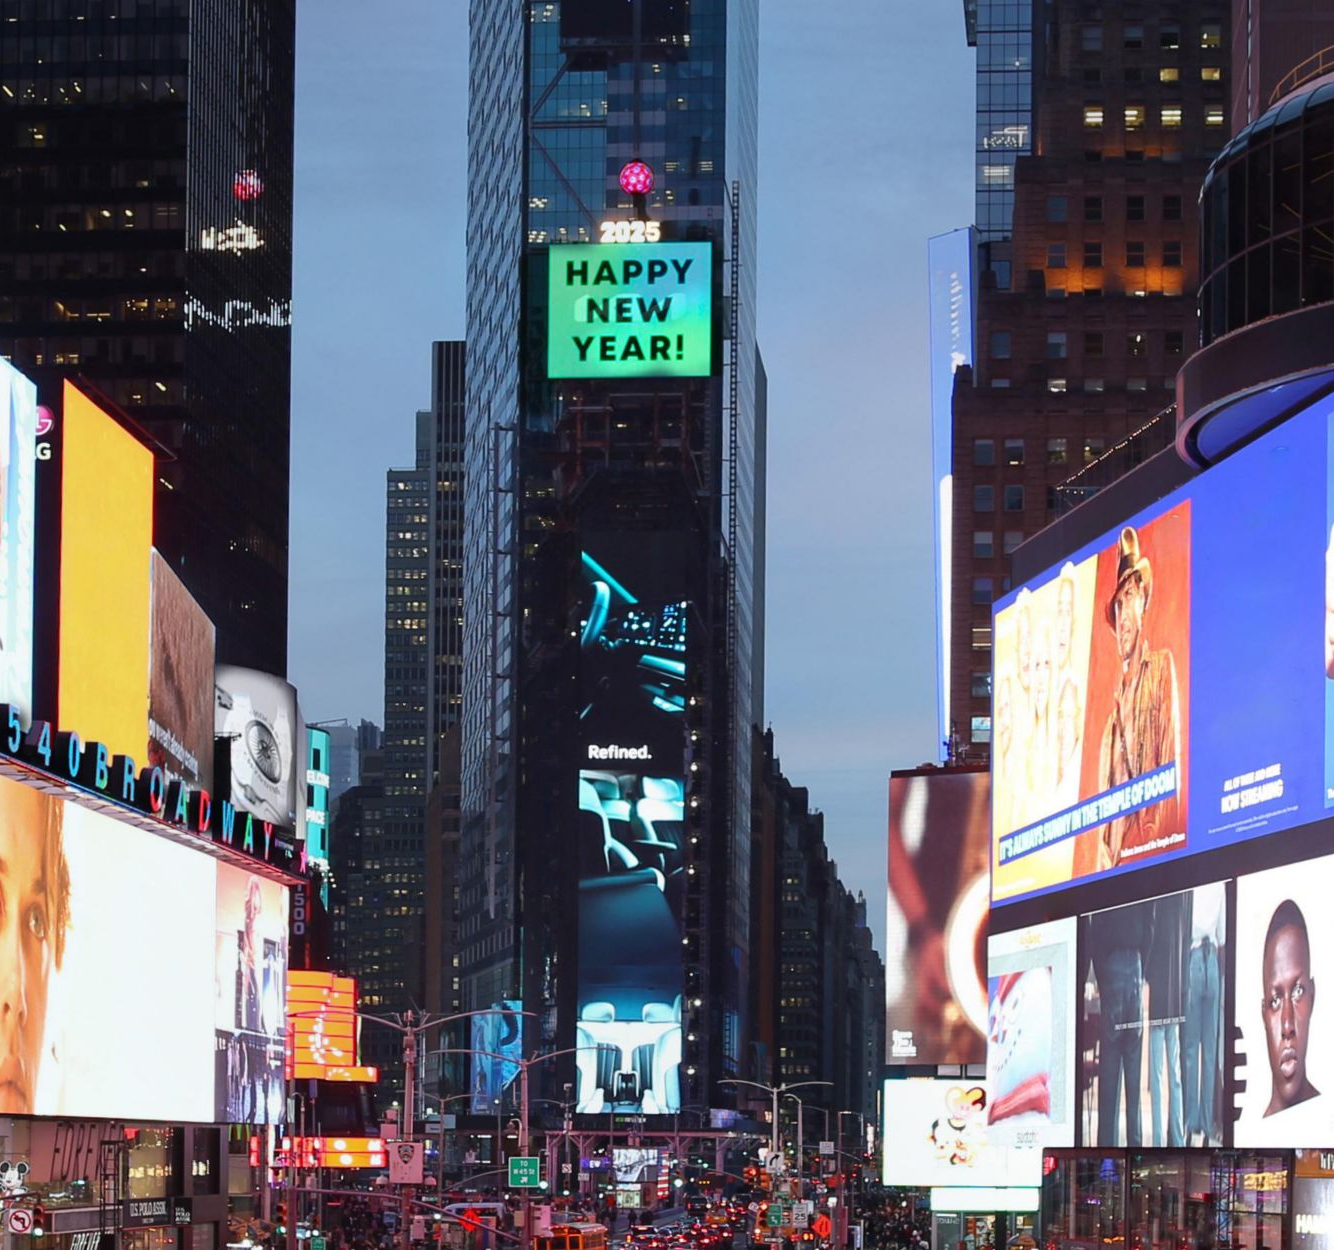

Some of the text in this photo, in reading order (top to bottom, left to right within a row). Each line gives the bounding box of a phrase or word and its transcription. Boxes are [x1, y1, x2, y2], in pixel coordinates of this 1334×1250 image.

[600, 221, 660, 243] 2025
[567, 259, 693, 285] HAPPY
[586, 297, 673, 323] NEW
[572, 334, 685, 361] YEAR!
[35, 443, 51, 459] G
[588, 744, 652, 760] Refined.
[96, 742, 273, 860] BROADWAY
[1012, 823, 1044, 856] ALWAYS
[1044, 811, 1072, 842] SUNNY
[1071, 808, 1082, 831] IN
[1082, 803, 1098, 827] THE
[1098, 788, 1131, 819] TEMPLE
[1131, 780, 1144, 806] OF
[1144, 767, 1175, 800] DOOM
[130, 1203, 139, 1217] U.S.
[140, 1202, 152, 1216] POLO
[794, 1213, 806, 1221] 25
